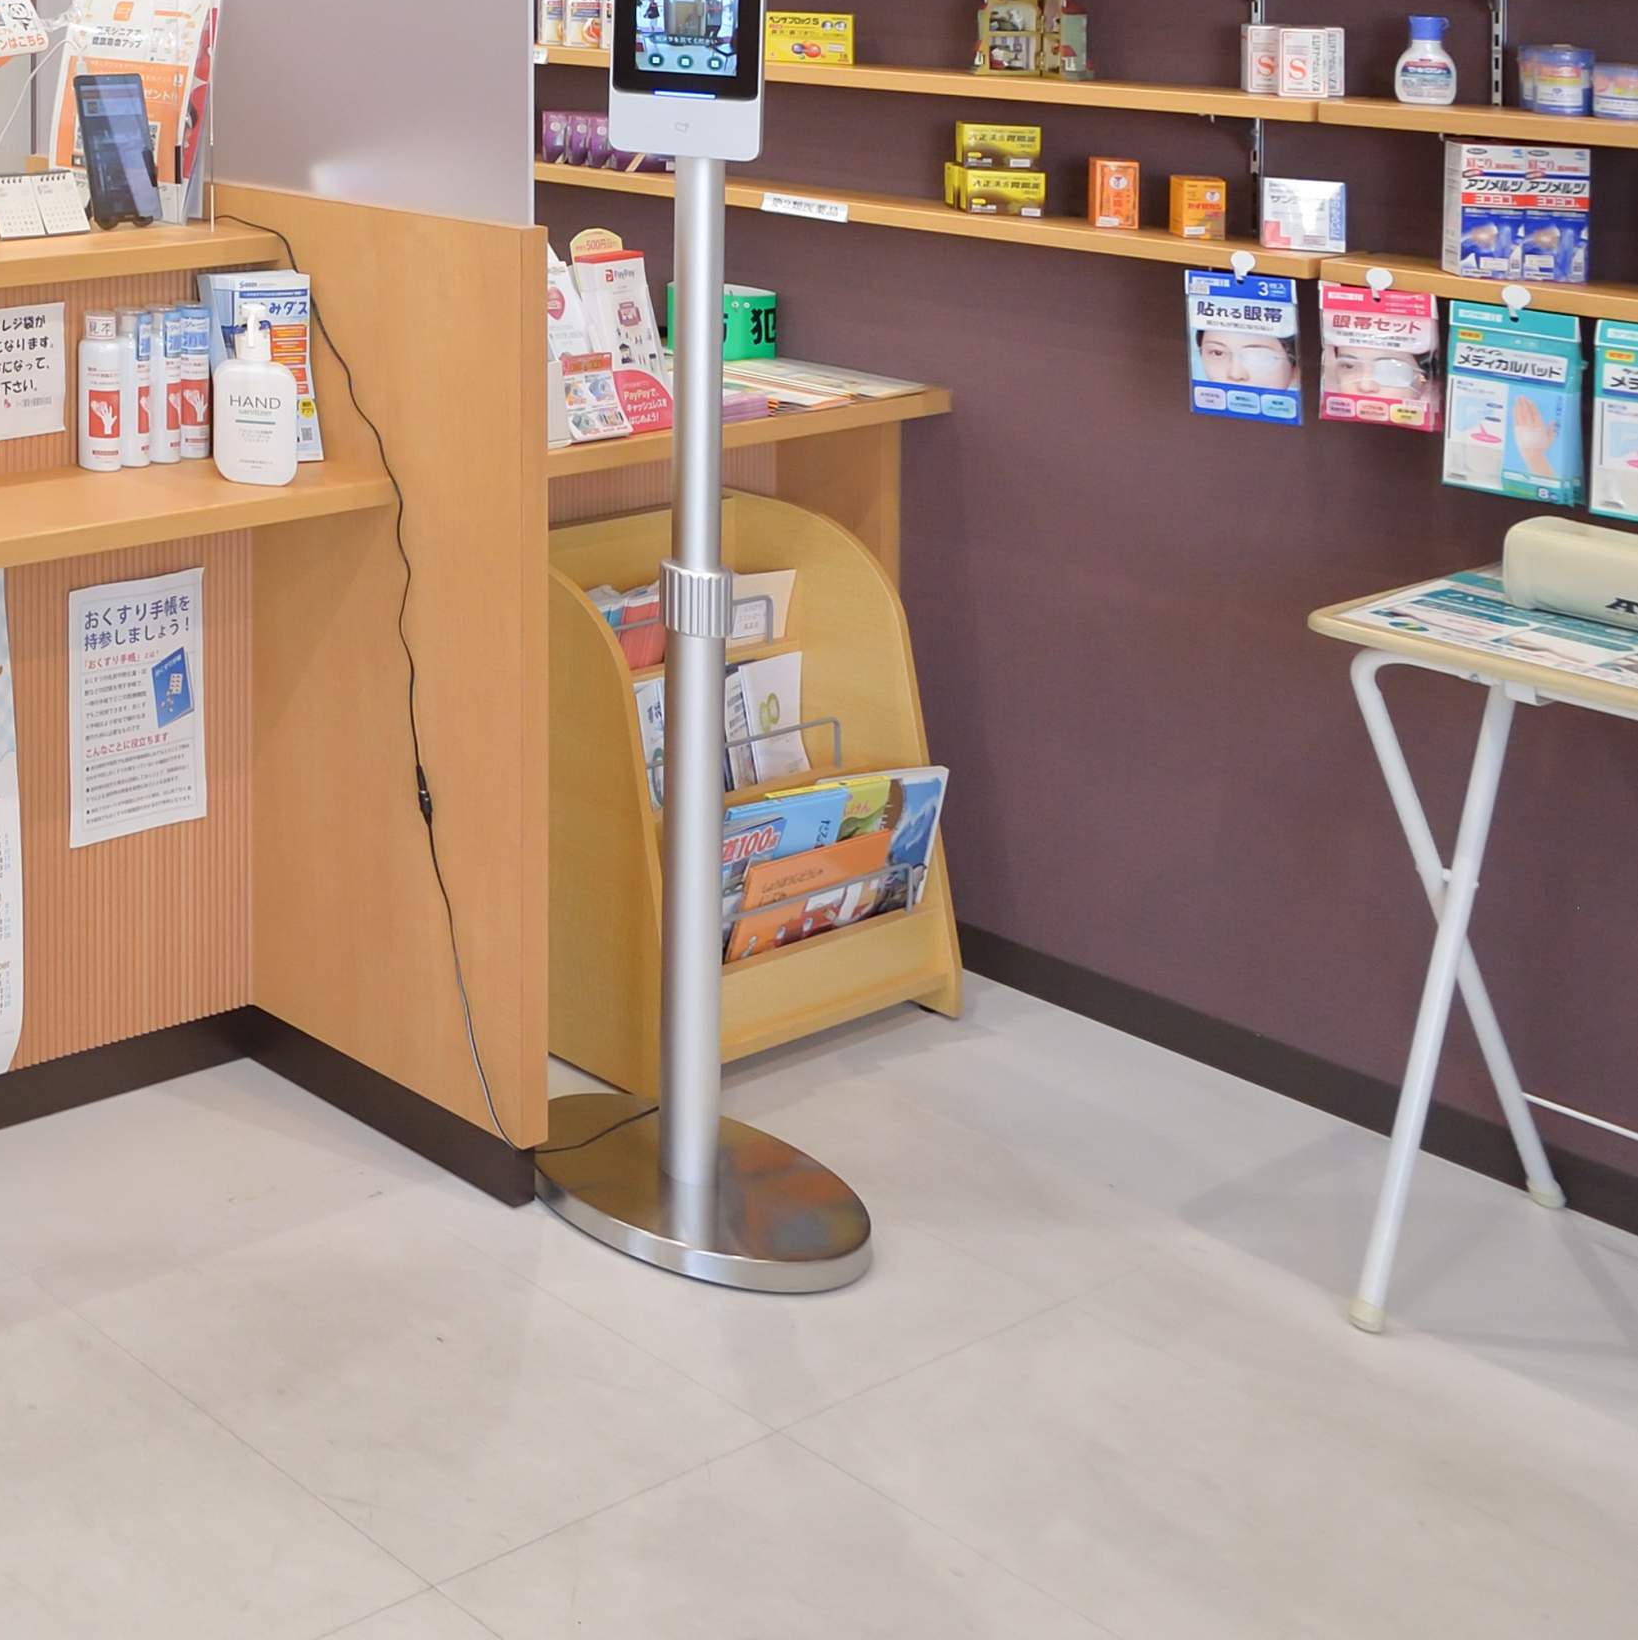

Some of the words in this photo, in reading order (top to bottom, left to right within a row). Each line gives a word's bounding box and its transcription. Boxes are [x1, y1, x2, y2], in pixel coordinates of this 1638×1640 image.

[1288, 57, 1307, 80] S
[1465, 179, 1524, 192] アンメルツ
[1526, 181, 1587, 194] アンメルツ
[614, 269, 635, 280] PayPay
[1197, 301, 1283, 323] 貼れる眼帯
[88, 320, 114, 338] 見本
[1332, 314, 1422, 334] 眼帯セット
[1457, 353, 1563, 378] メディカルパッド
[229, 394, 282, 411] HAND
[238, 408, 273, 417] sanitizer
[83, 595, 191, 631] おくすり手帳を
[85, 732, 169, 758] こんなことに役立ちます
